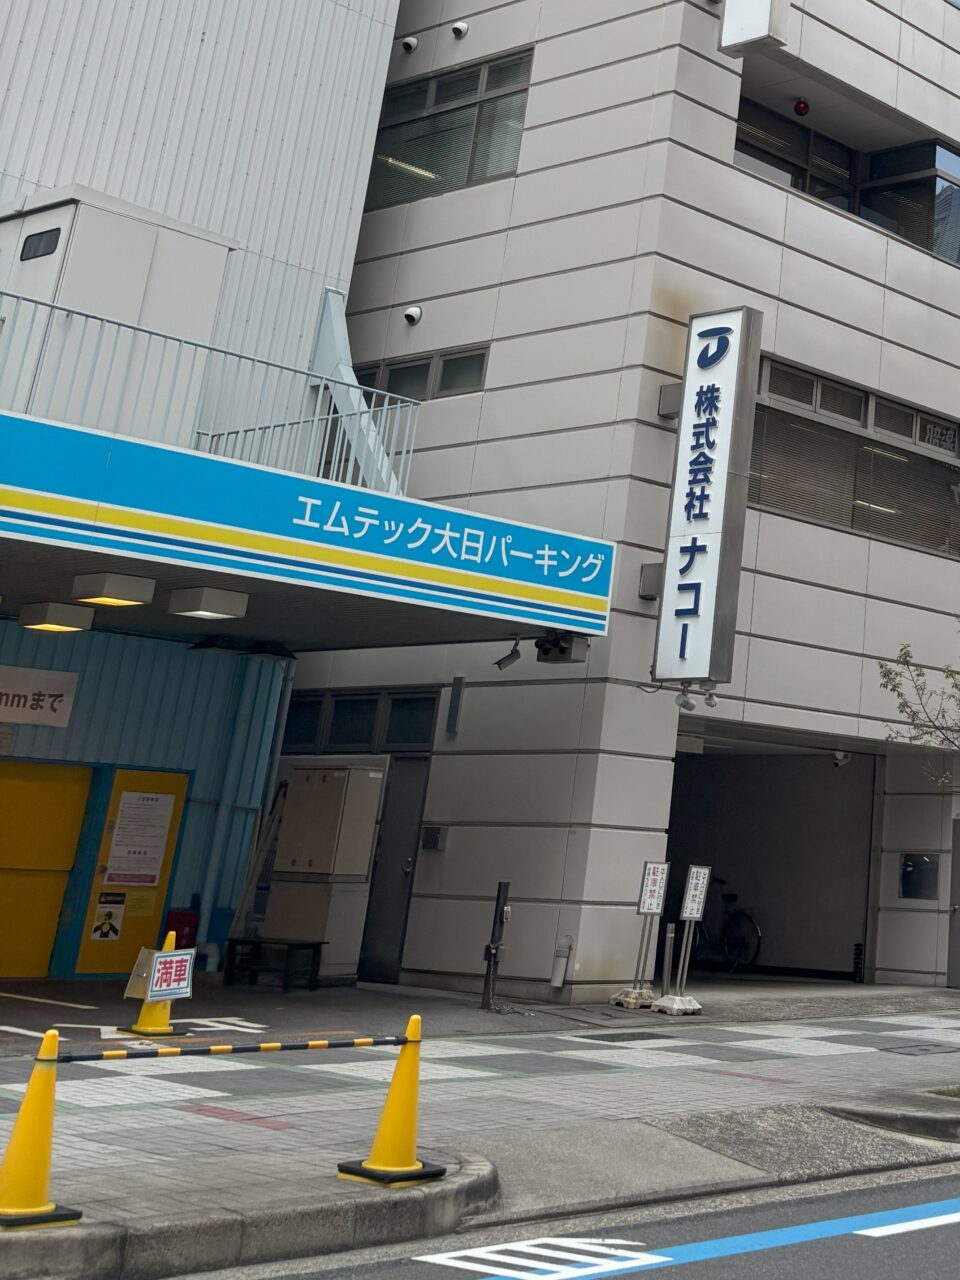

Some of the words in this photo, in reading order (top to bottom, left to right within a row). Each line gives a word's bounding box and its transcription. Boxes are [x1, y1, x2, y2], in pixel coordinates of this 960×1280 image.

[684, 384, 722, 522] 株式会社
[292, 495, 605, 583] エムテック大日パーキング
[674, 536, 708, 660] ナコー
[154, 957, 189, 988] 満車
